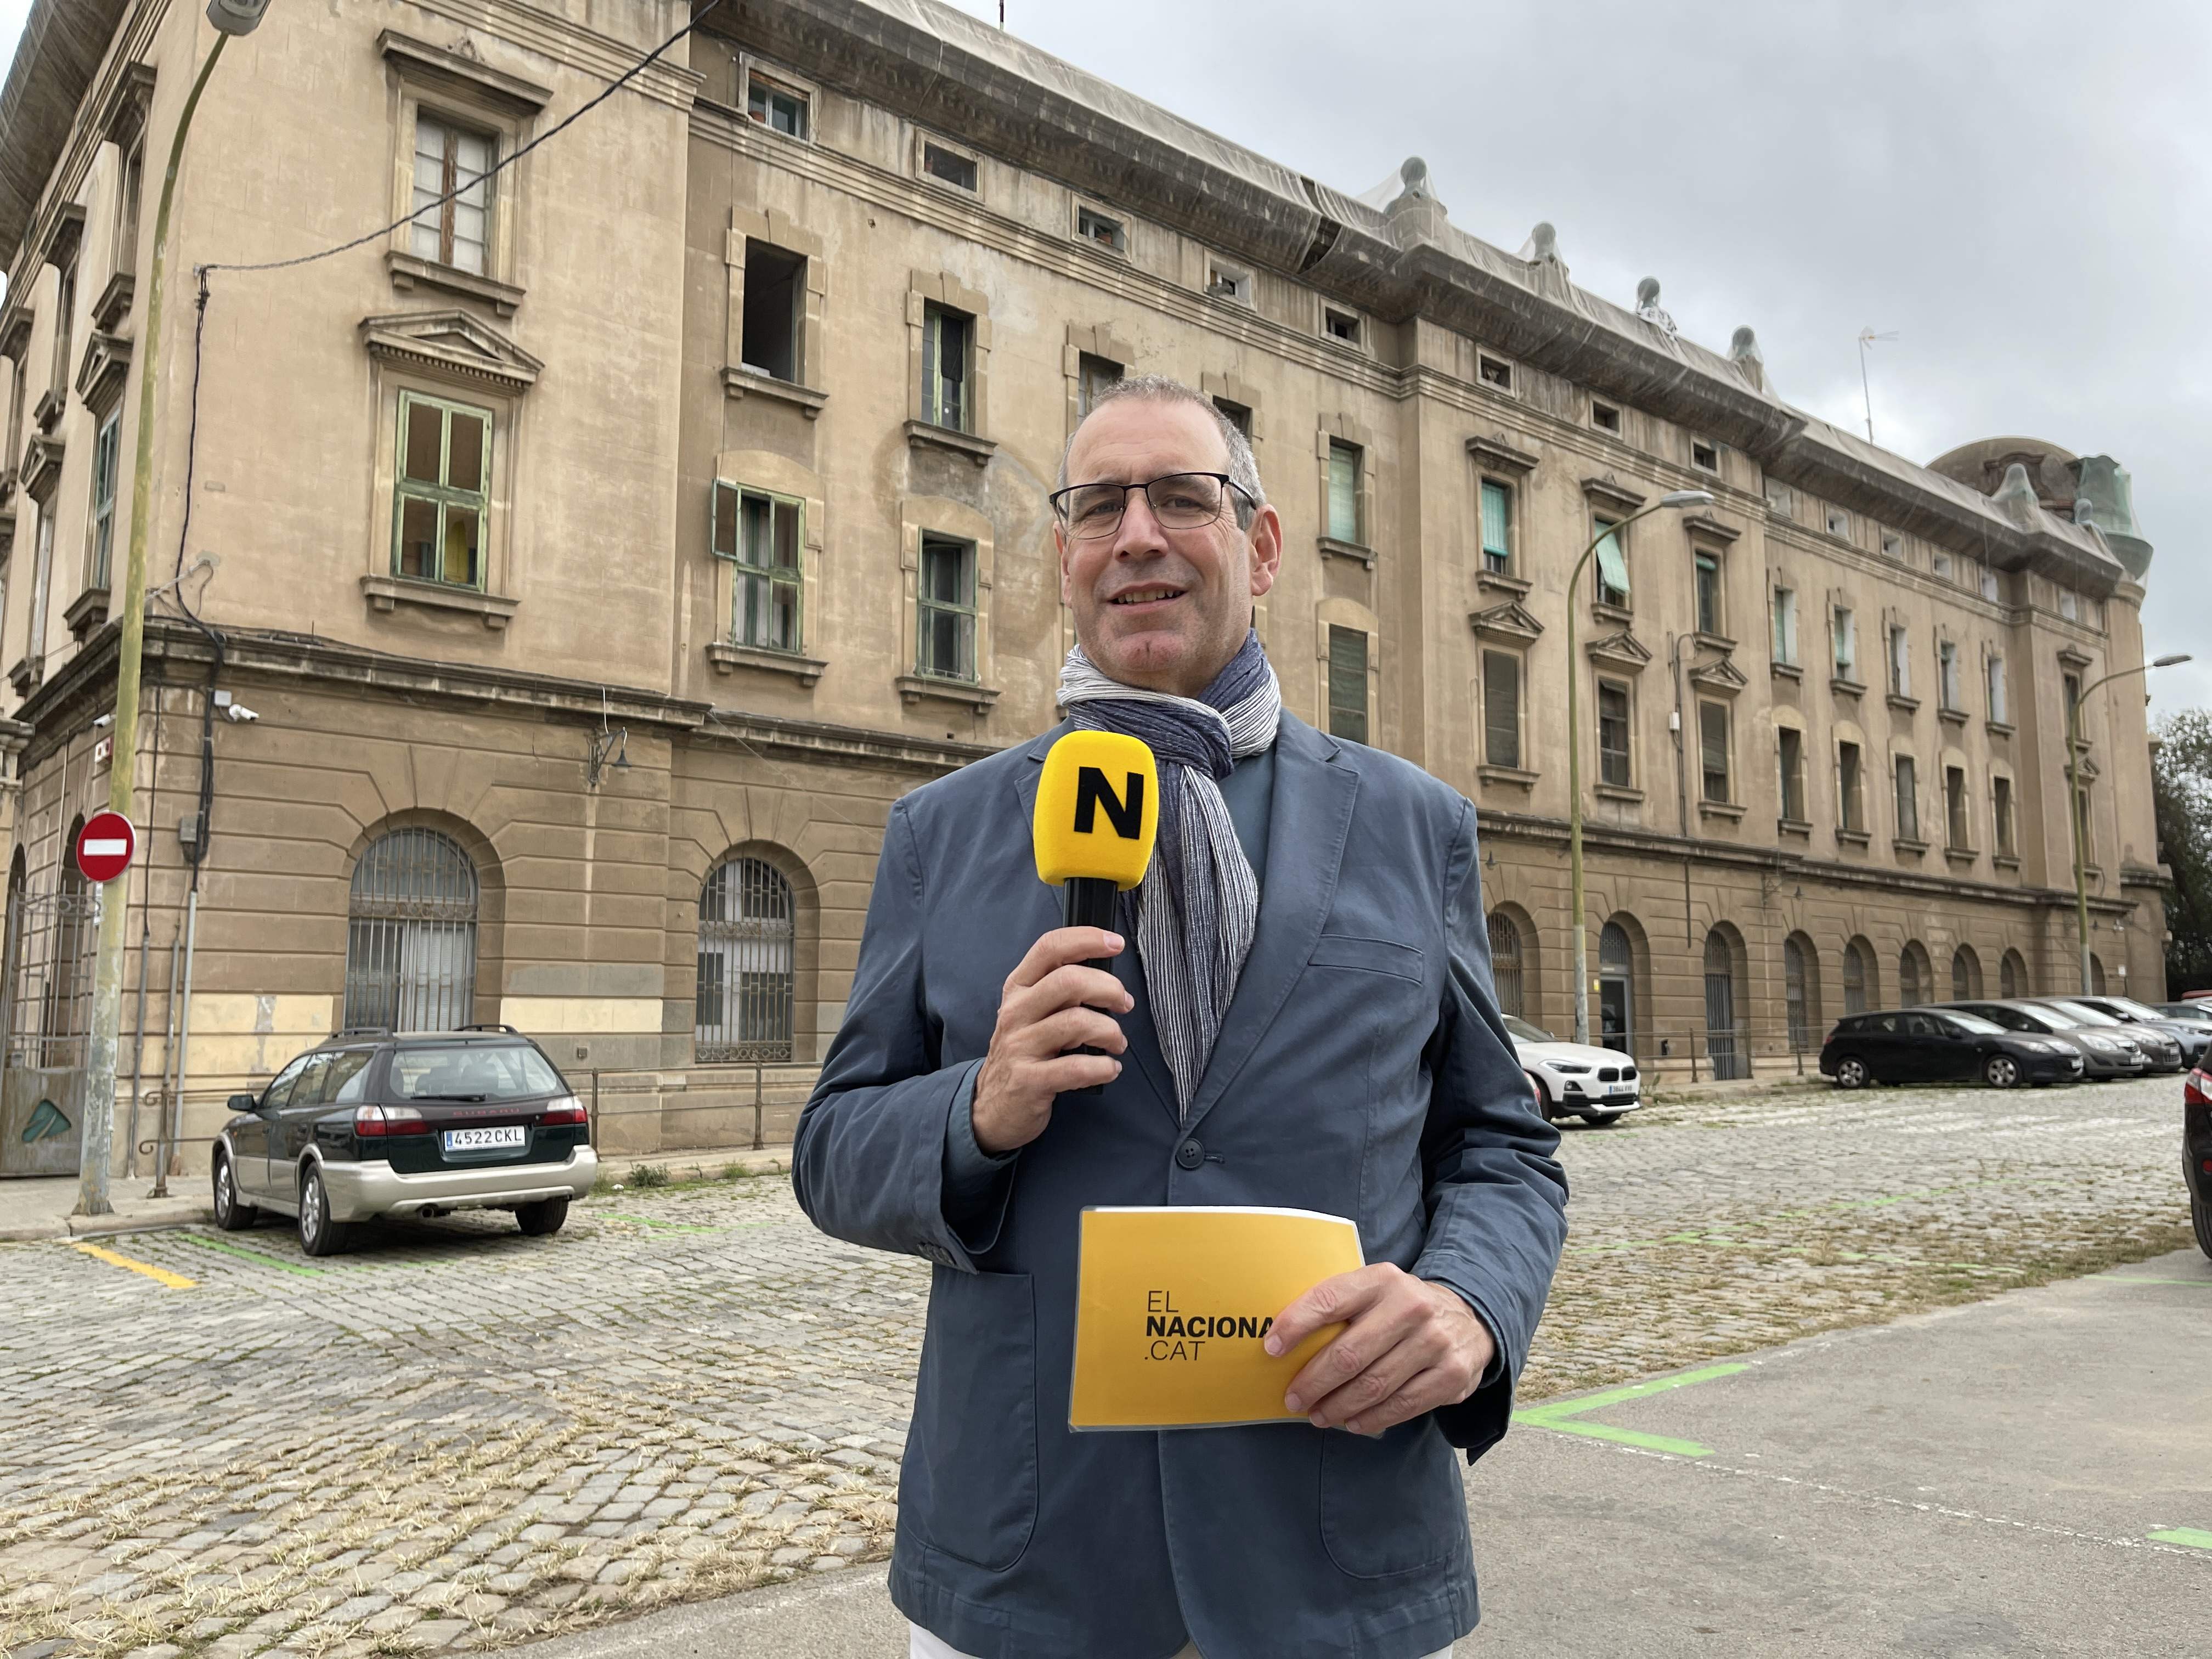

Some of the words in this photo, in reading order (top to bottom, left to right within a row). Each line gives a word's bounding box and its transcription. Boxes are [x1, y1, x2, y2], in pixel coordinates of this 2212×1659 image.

[1074, 766, 1144, 840] N
[1148, 1290, 1179, 1312] EL
[1146, 1316, 1273, 1338] NACIONA
[1144, 1340, 1206, 1361] .CAT
